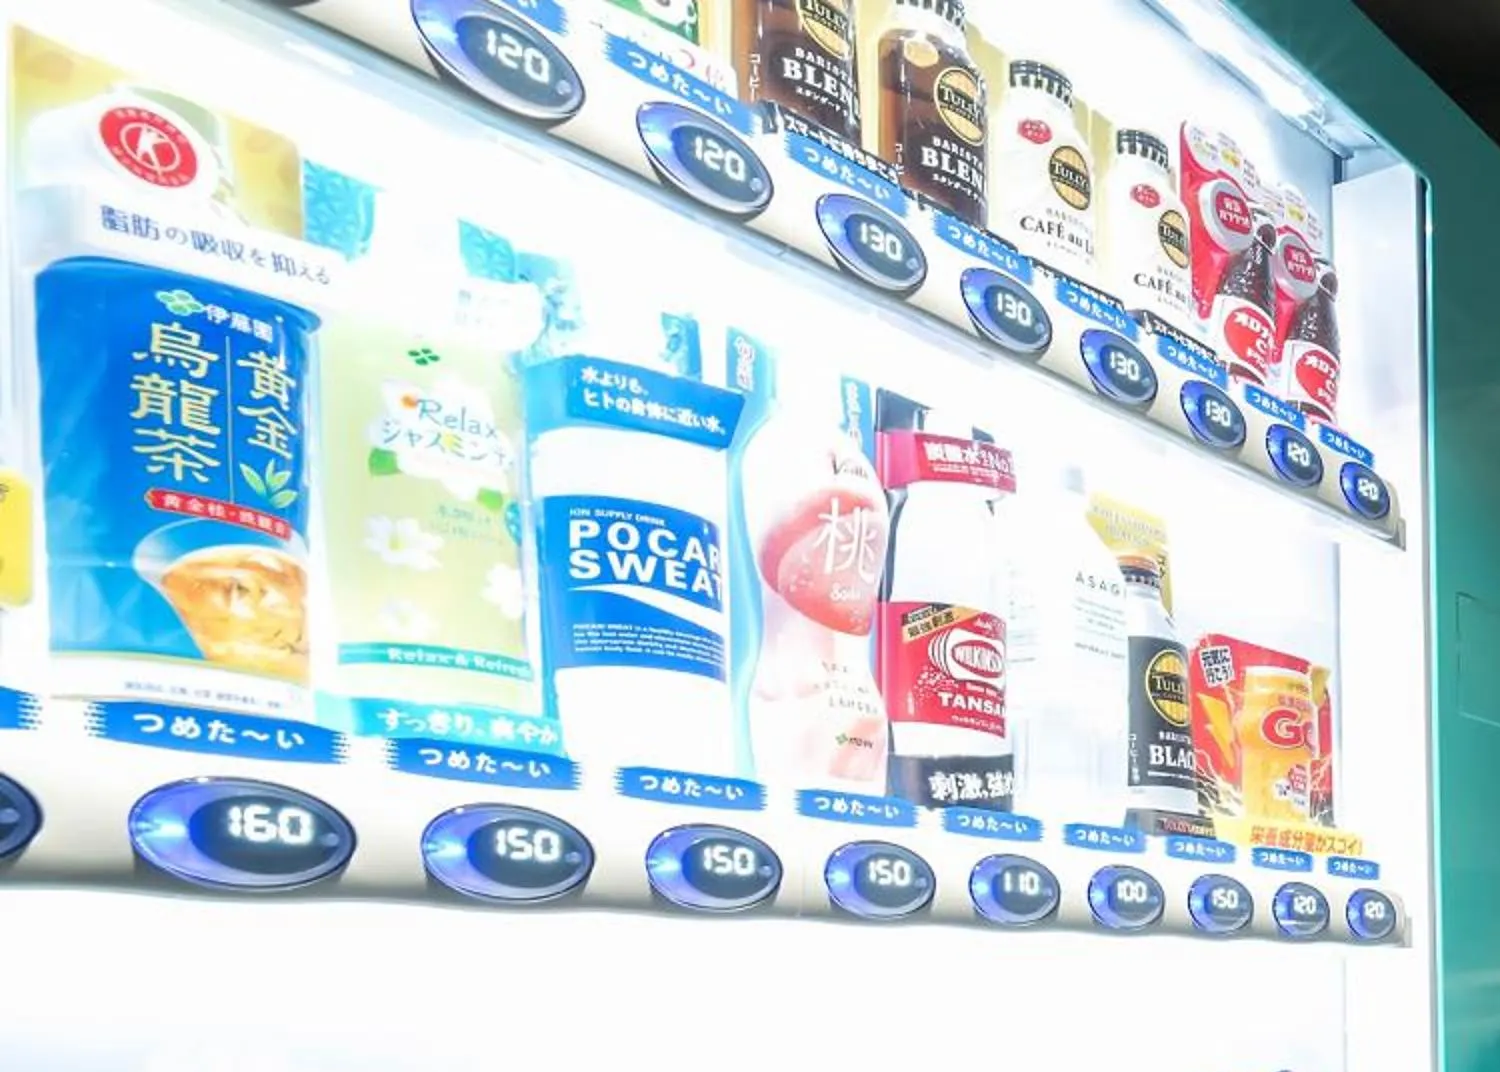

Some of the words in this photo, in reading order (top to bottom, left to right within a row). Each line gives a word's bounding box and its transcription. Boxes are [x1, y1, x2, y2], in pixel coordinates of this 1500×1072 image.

[485, 27, 552, 85] 120
[628, 51, 735, 116] つめた～い
[694, 134, 746, 182] 120
[803, 146, 890, 201] つめた～い
[100, 204, 333, 288] 脂肪の吸収を抑える
[858, 222, 903, 260] 130
[946, 224, 1019, 270] つめた～い
[996, 287, 1032, 328] 130
[1109, 350, 1140, 382] 130
[237, 349, 299, 460] 黄金
[416, 397, 499, 440] Relax
[1203, 399, 1231, 428] 130
[812, 496, 884, 583] 桃
[133, 711, 305, 751] つめた～い
[418, 746, 552, 782] つめた～い
[638, 775, 746, 801] つめた～い
[813, 795, 900, 819] つめた～い
[227, 804, 313, 845] 160
[956, 813, 1029, 835] つめた～い
[494, 827, 563, 863] 150
[702, 846, 757, 875] 150
[866, 859, 912, 887] 150
[1002, 865, 1041, 896] 110
[1210, 889, 1239, 910] 150
